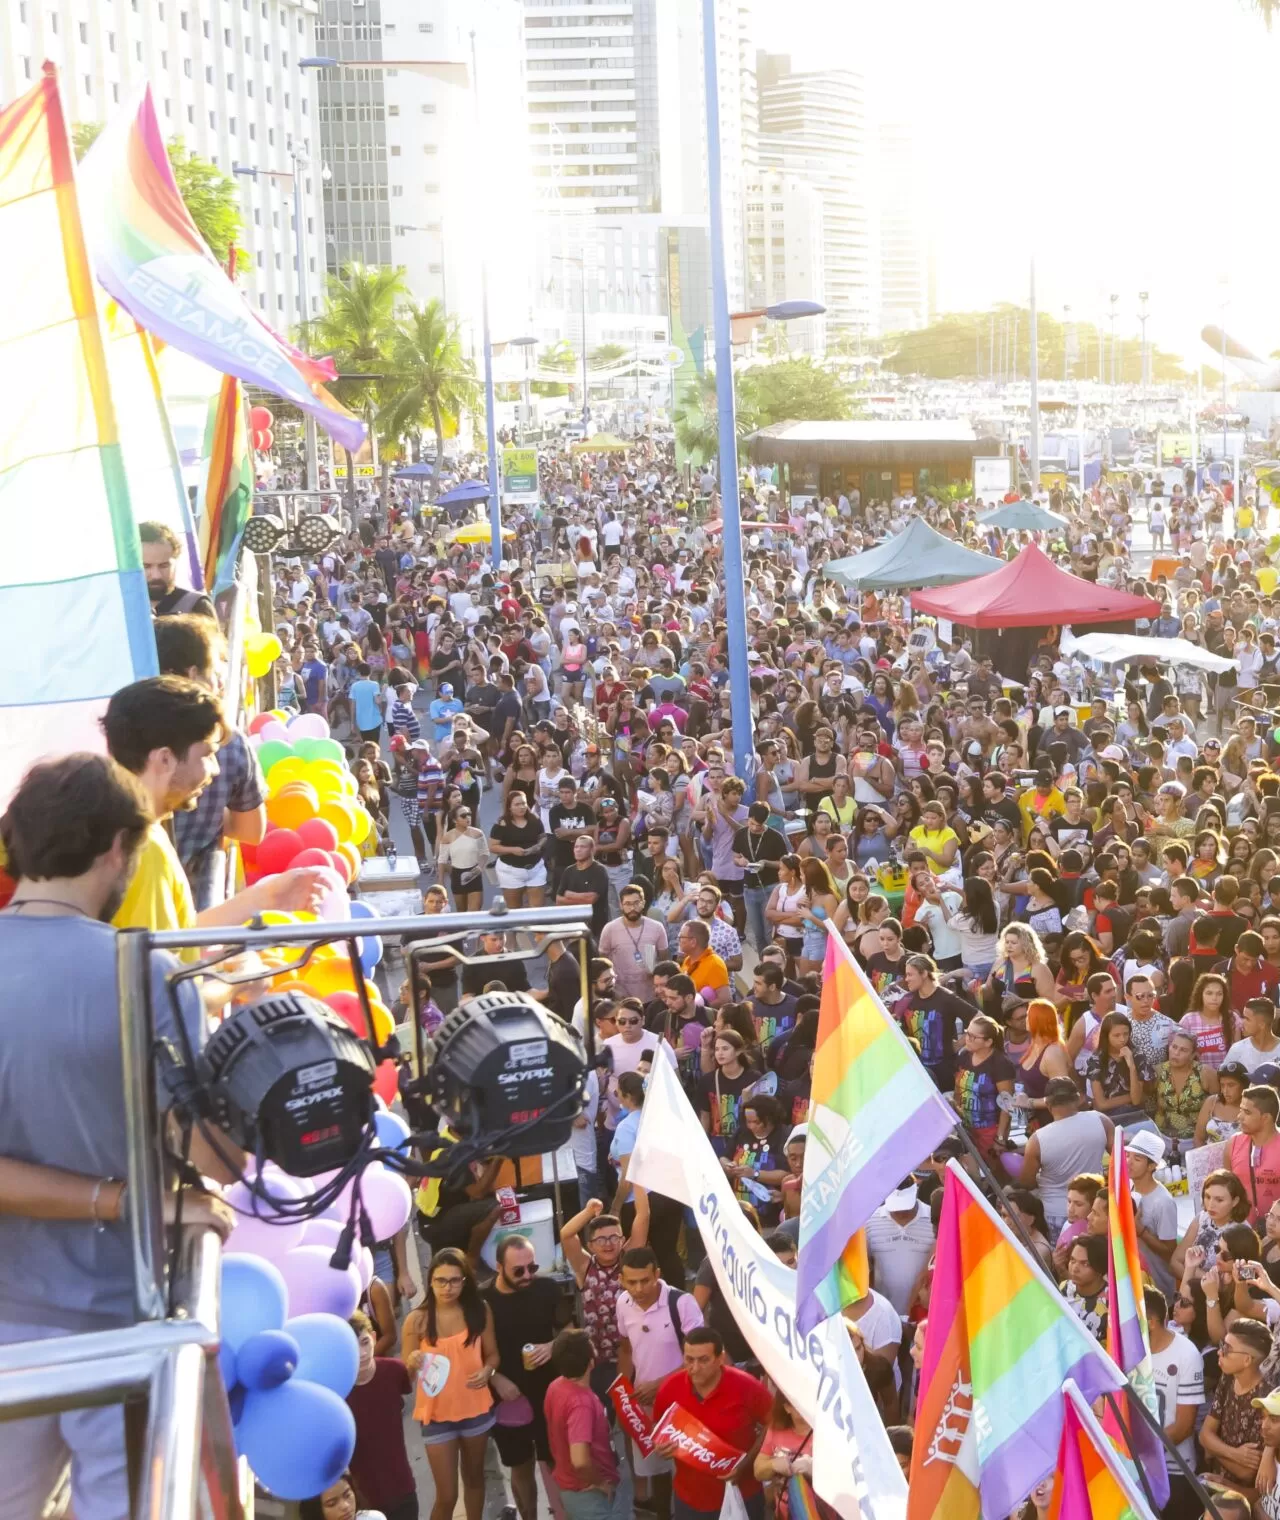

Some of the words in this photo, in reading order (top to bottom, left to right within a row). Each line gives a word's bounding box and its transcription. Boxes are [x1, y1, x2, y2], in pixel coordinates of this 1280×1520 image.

[129, 271, 281, 378] FETAMCE
[497, 1066, 554, 1085] SKYPIX
[284, 1085, 344, 1112] SKYPIX
[614, 1384, 646, 1434] DIRETAS
[660, 1423, 715, 1463] DIRETAS
